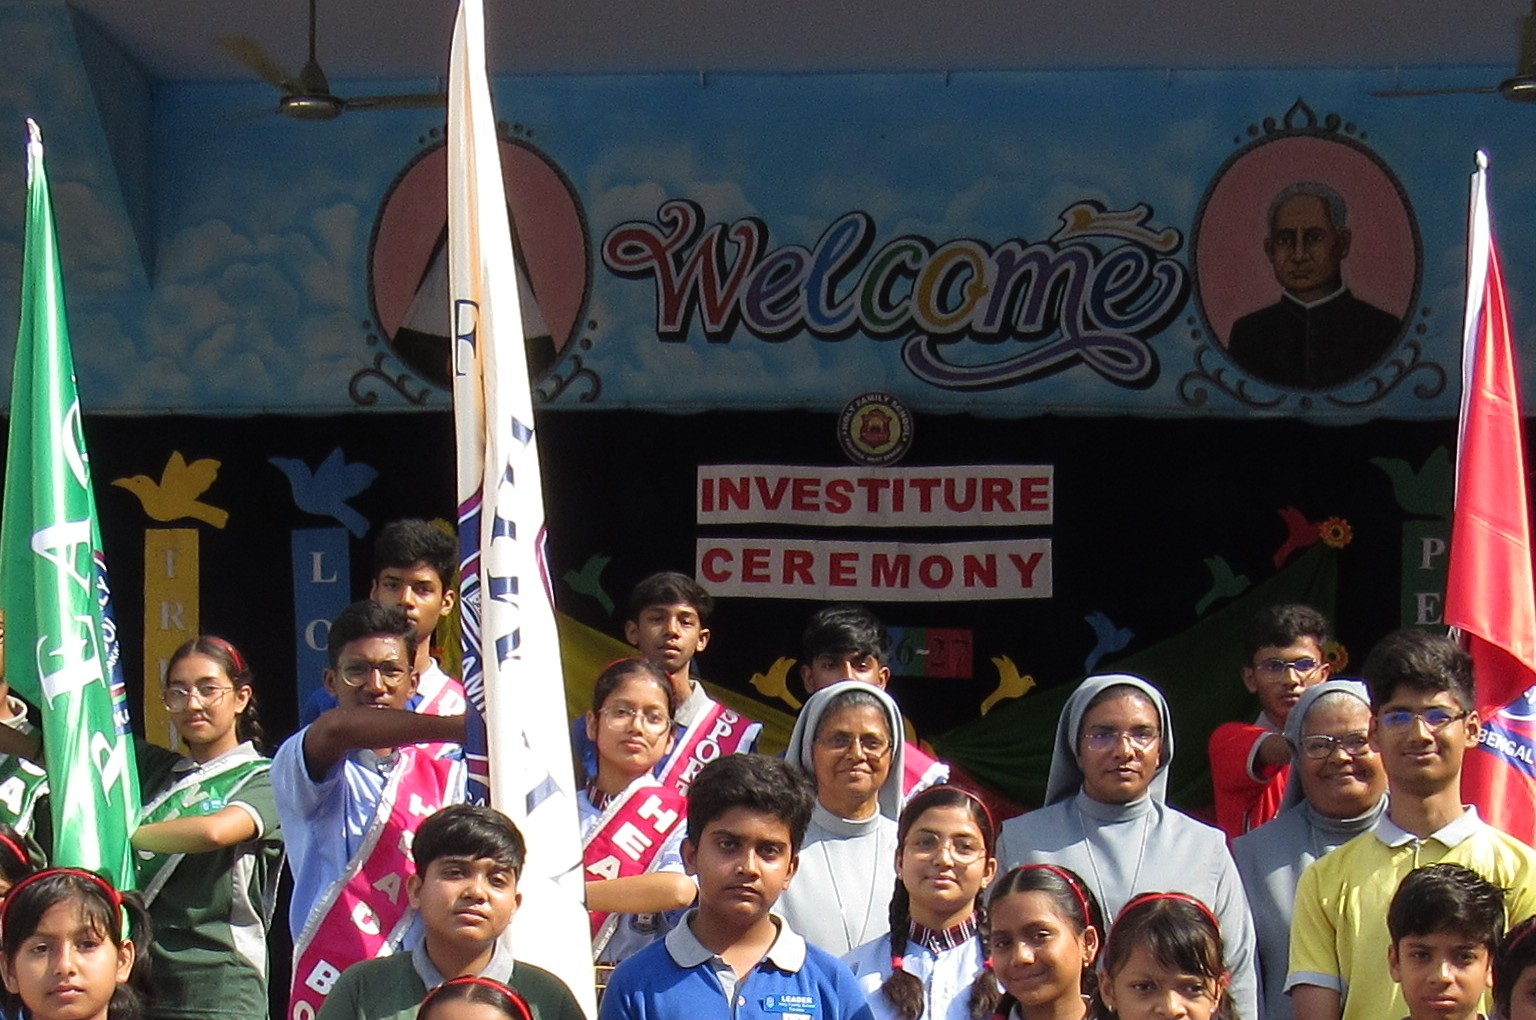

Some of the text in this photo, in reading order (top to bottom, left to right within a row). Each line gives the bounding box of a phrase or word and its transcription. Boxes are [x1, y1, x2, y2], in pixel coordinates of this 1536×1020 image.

[601, 199, 1192, 391] Welcome
[701, 476, 1050, 514] INVESTITURE
[701, 548, 1044, 590] CEREMONY
[1477, 728, 1535, 764] BENGAL
[781, 995, 813, 1004] LEADER
